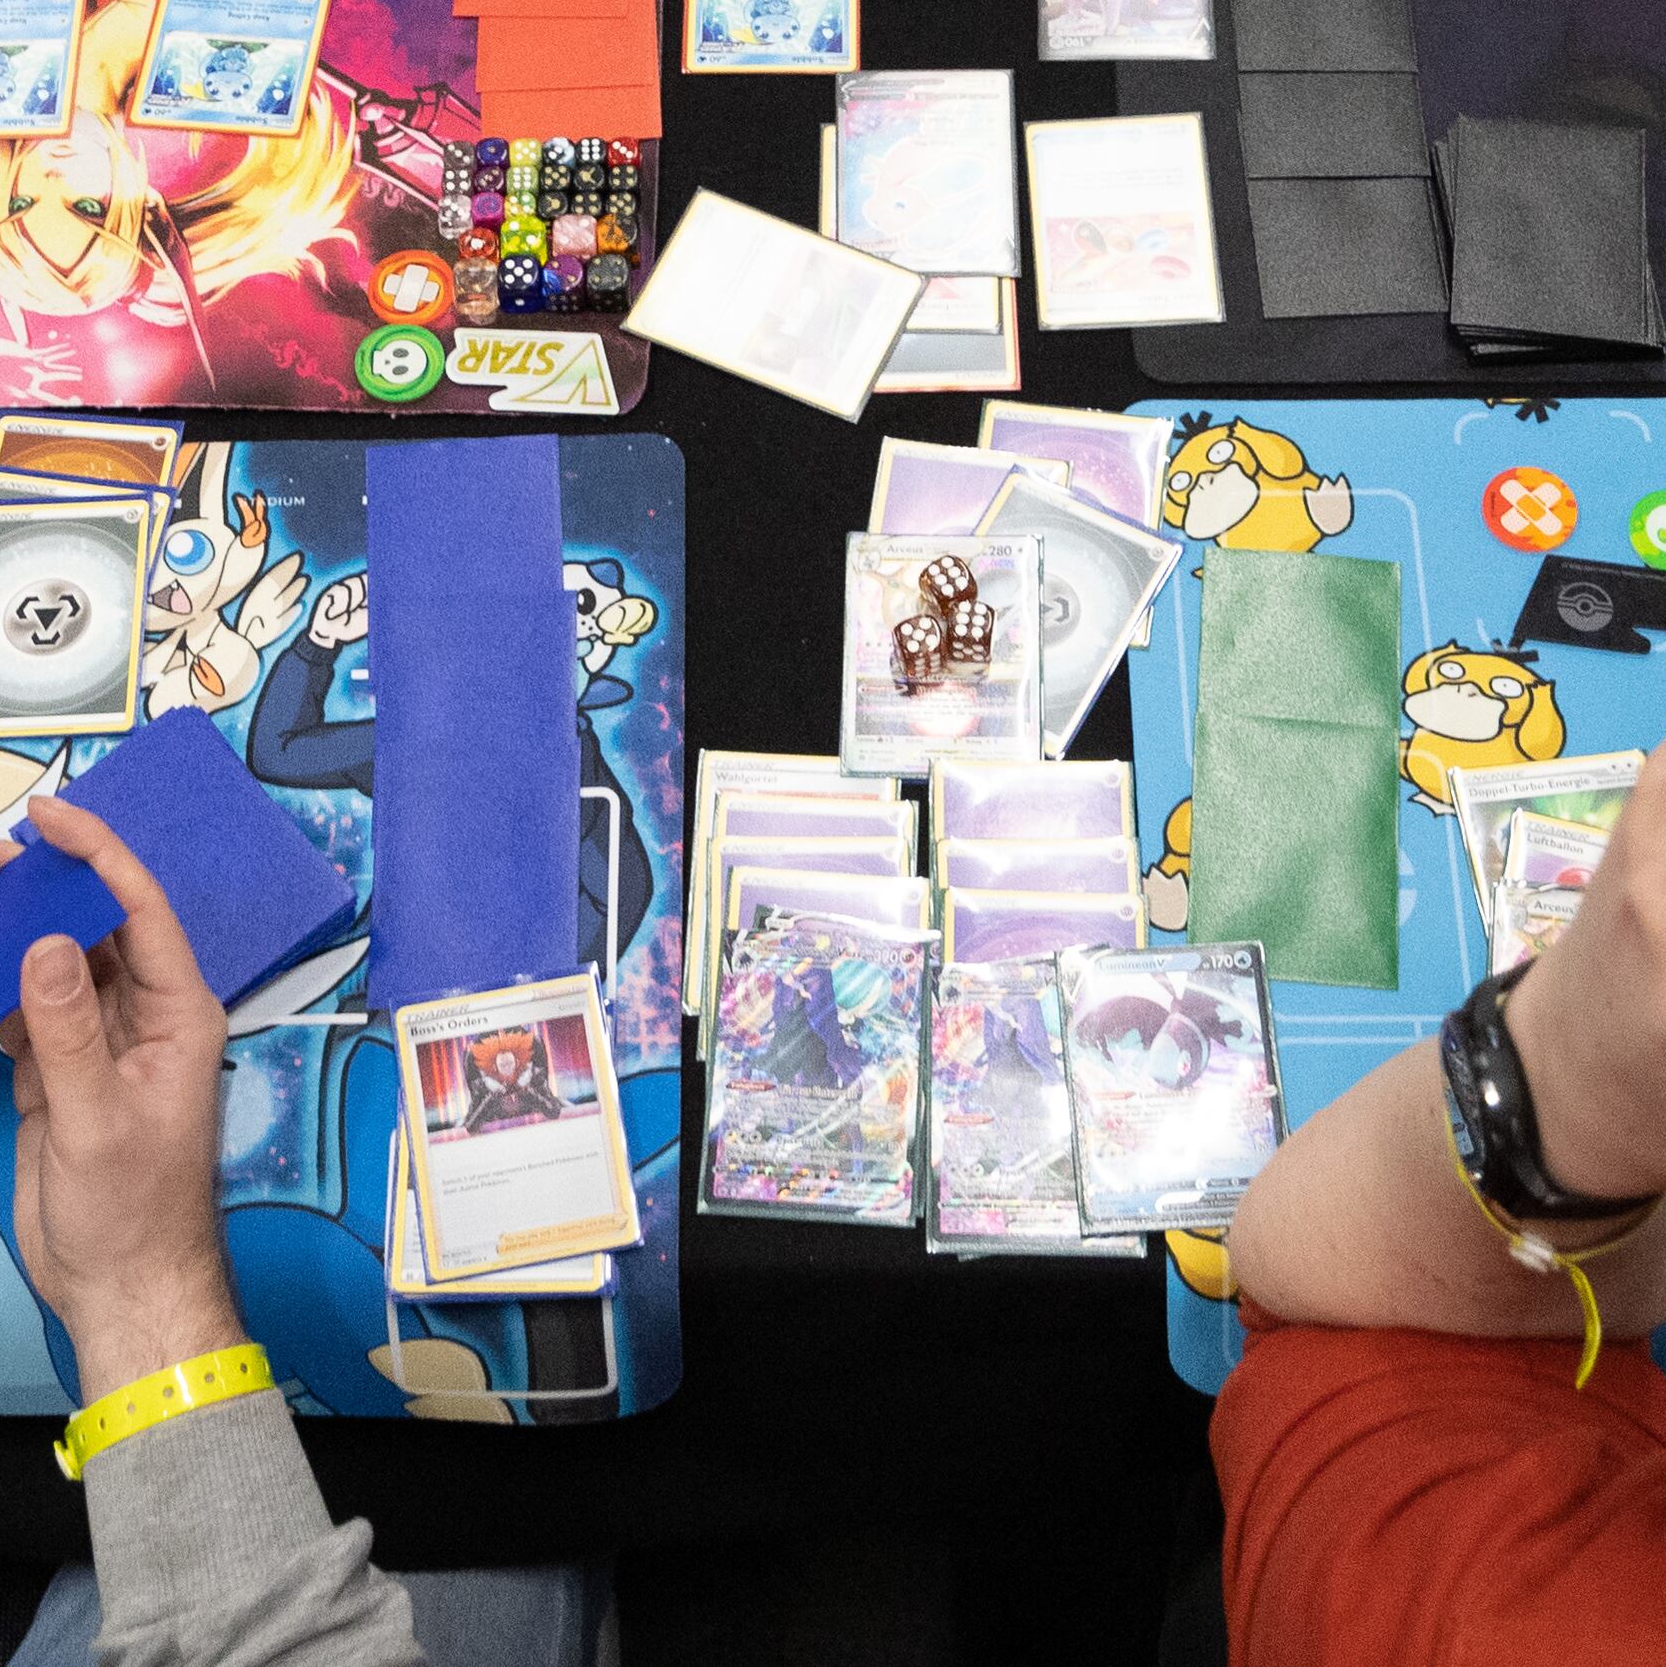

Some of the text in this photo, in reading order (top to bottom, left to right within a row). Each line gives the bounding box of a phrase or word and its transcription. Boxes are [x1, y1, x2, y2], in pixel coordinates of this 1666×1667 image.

[456, 338, 566, 377] STAR
[988, 544, 1013, 556] 280
[1468, 776, 1591, 800] Doppel-Turbo-Energie
[1526, 832, 1585, 855] Luftballon
[1209, 956, 1234, 969] 170
[410, 1014, 489, 1038] Boss's Orders
